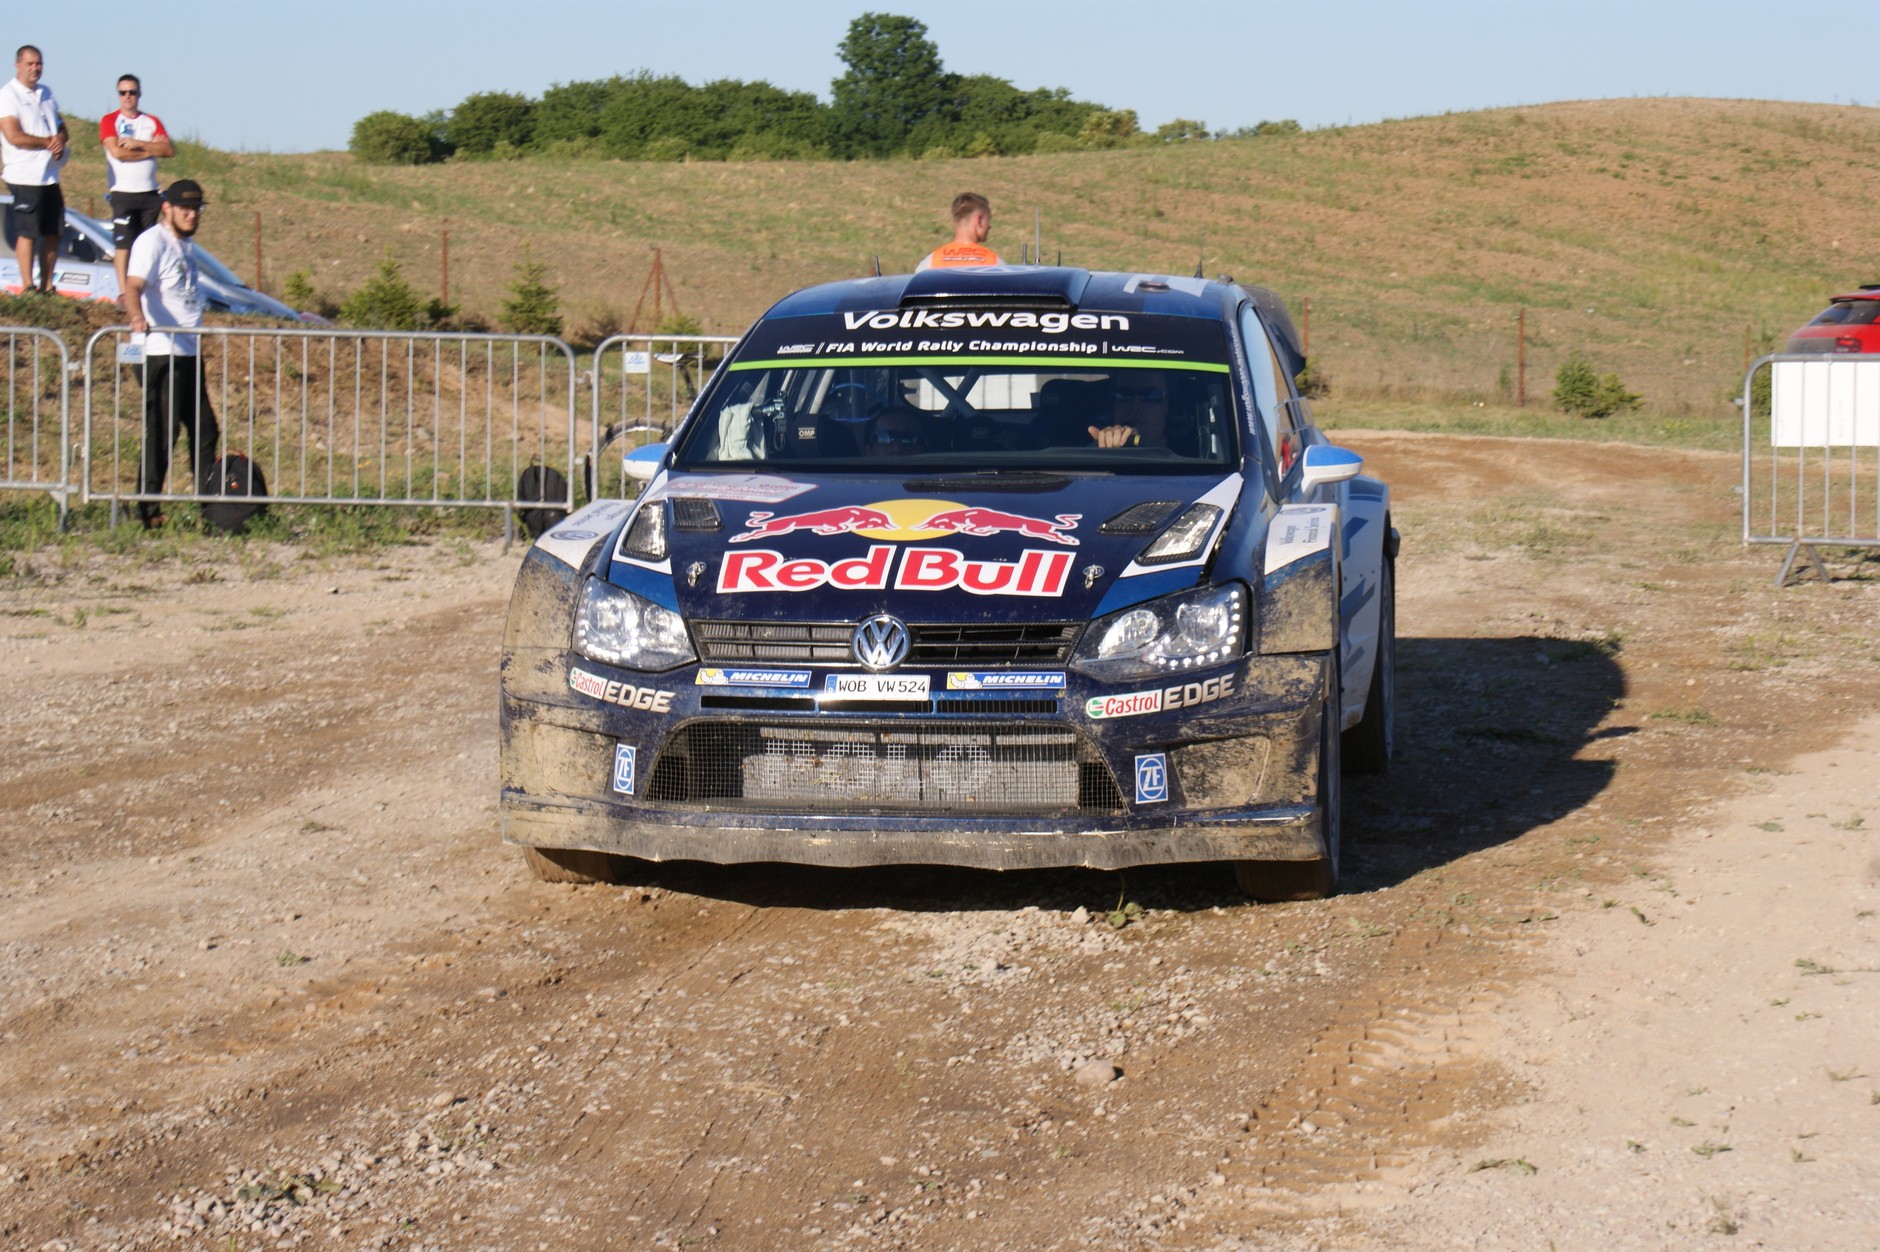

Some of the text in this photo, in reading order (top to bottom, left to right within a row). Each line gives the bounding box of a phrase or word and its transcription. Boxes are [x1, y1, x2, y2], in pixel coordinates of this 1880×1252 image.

[843, 310, 1130, 334] Volkswagen
[825, 343, 854, 353] FIA
[861, 341, 913, 352] World
[917, 340, 964, 353] Rally
[968, 340, 1098, 354] Championship
[798, 429, 816, 437] OMP
[718, 546, 1071, 594] Red Bull
[729, 671, 808, 682] MICHELIN
[982, 675, 1063, 685] MICHELIN
[575, 672, 676, 714] Castrol EDGE
[838, 680, 867, 693] WOB
[898, 680, 927, 693] 524
[1105, 672, 1235, 716] Castrol EDGE
[1141, 765, 1165, 792] ZF
